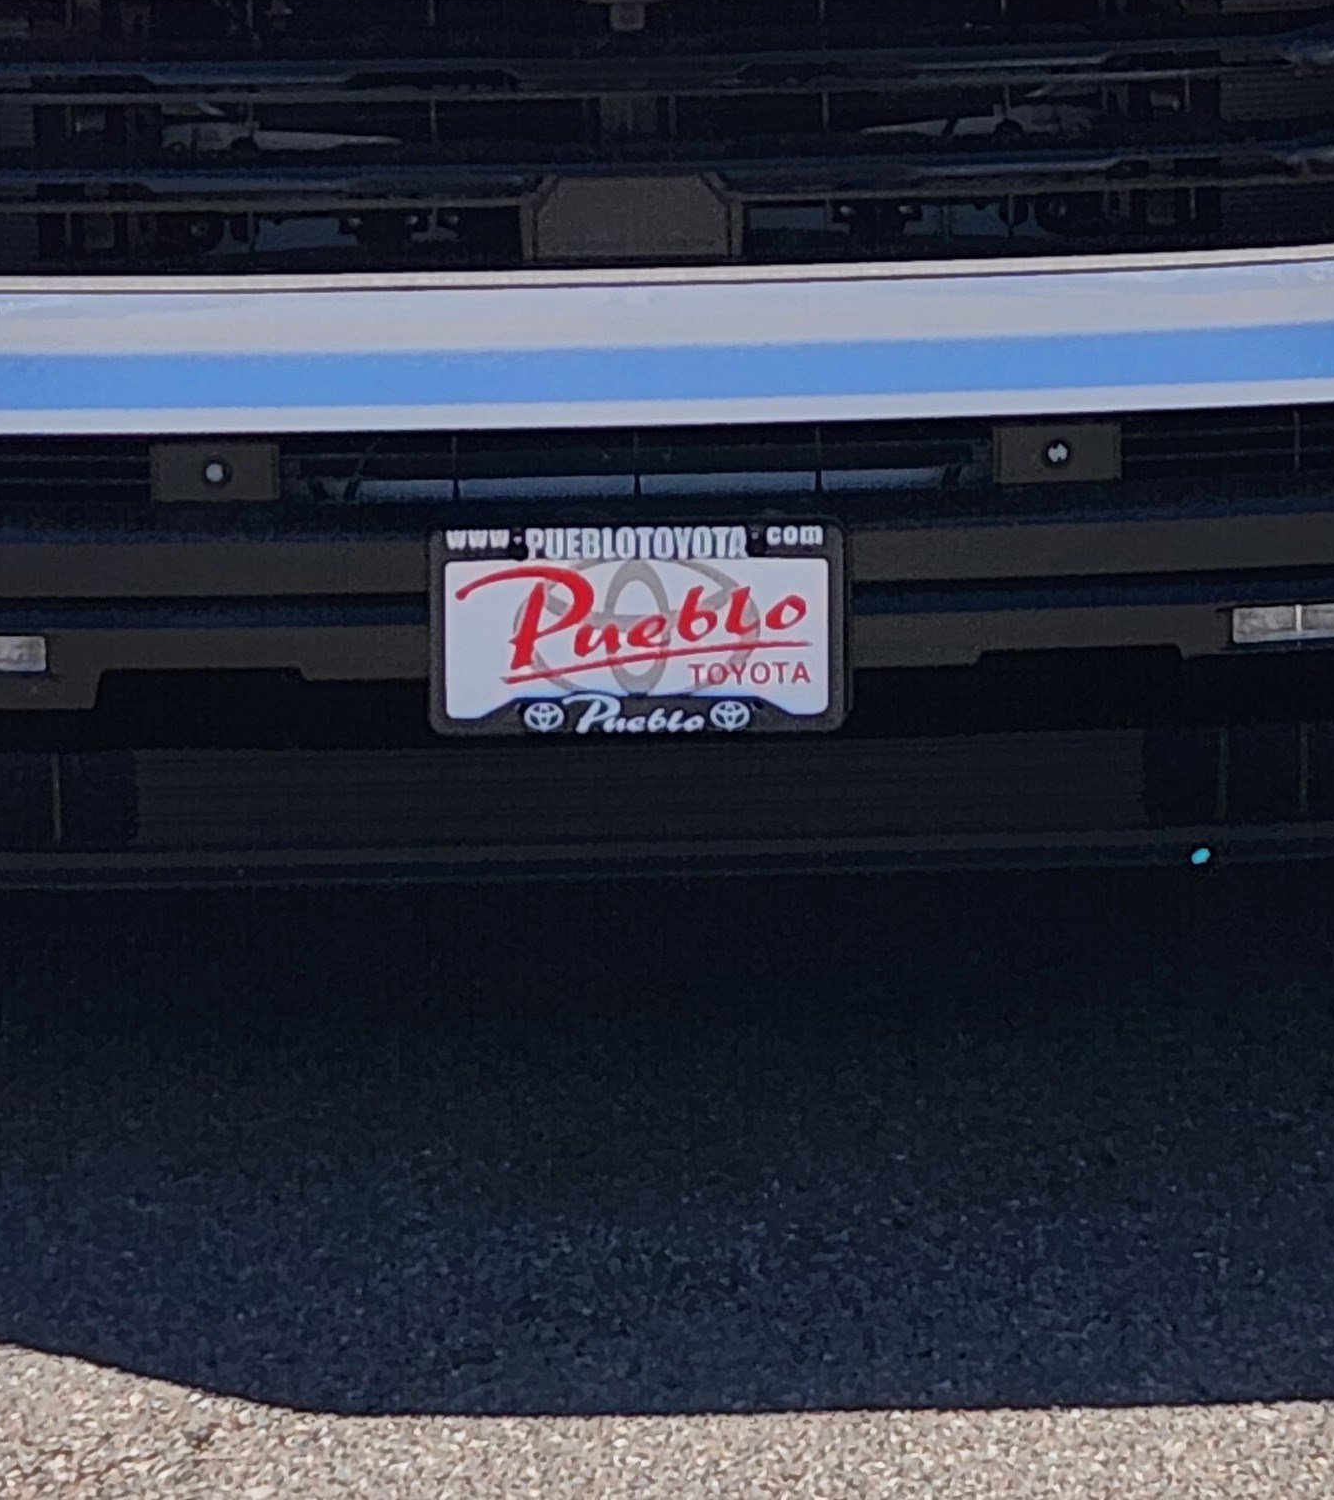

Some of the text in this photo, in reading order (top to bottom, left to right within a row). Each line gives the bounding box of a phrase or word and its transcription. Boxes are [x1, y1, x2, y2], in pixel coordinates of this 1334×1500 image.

[455, 566, 807, 670] Pueblo
[688, 661, 811, 686] TOYOTA
[564, 694, 705, 734] Pueblo
